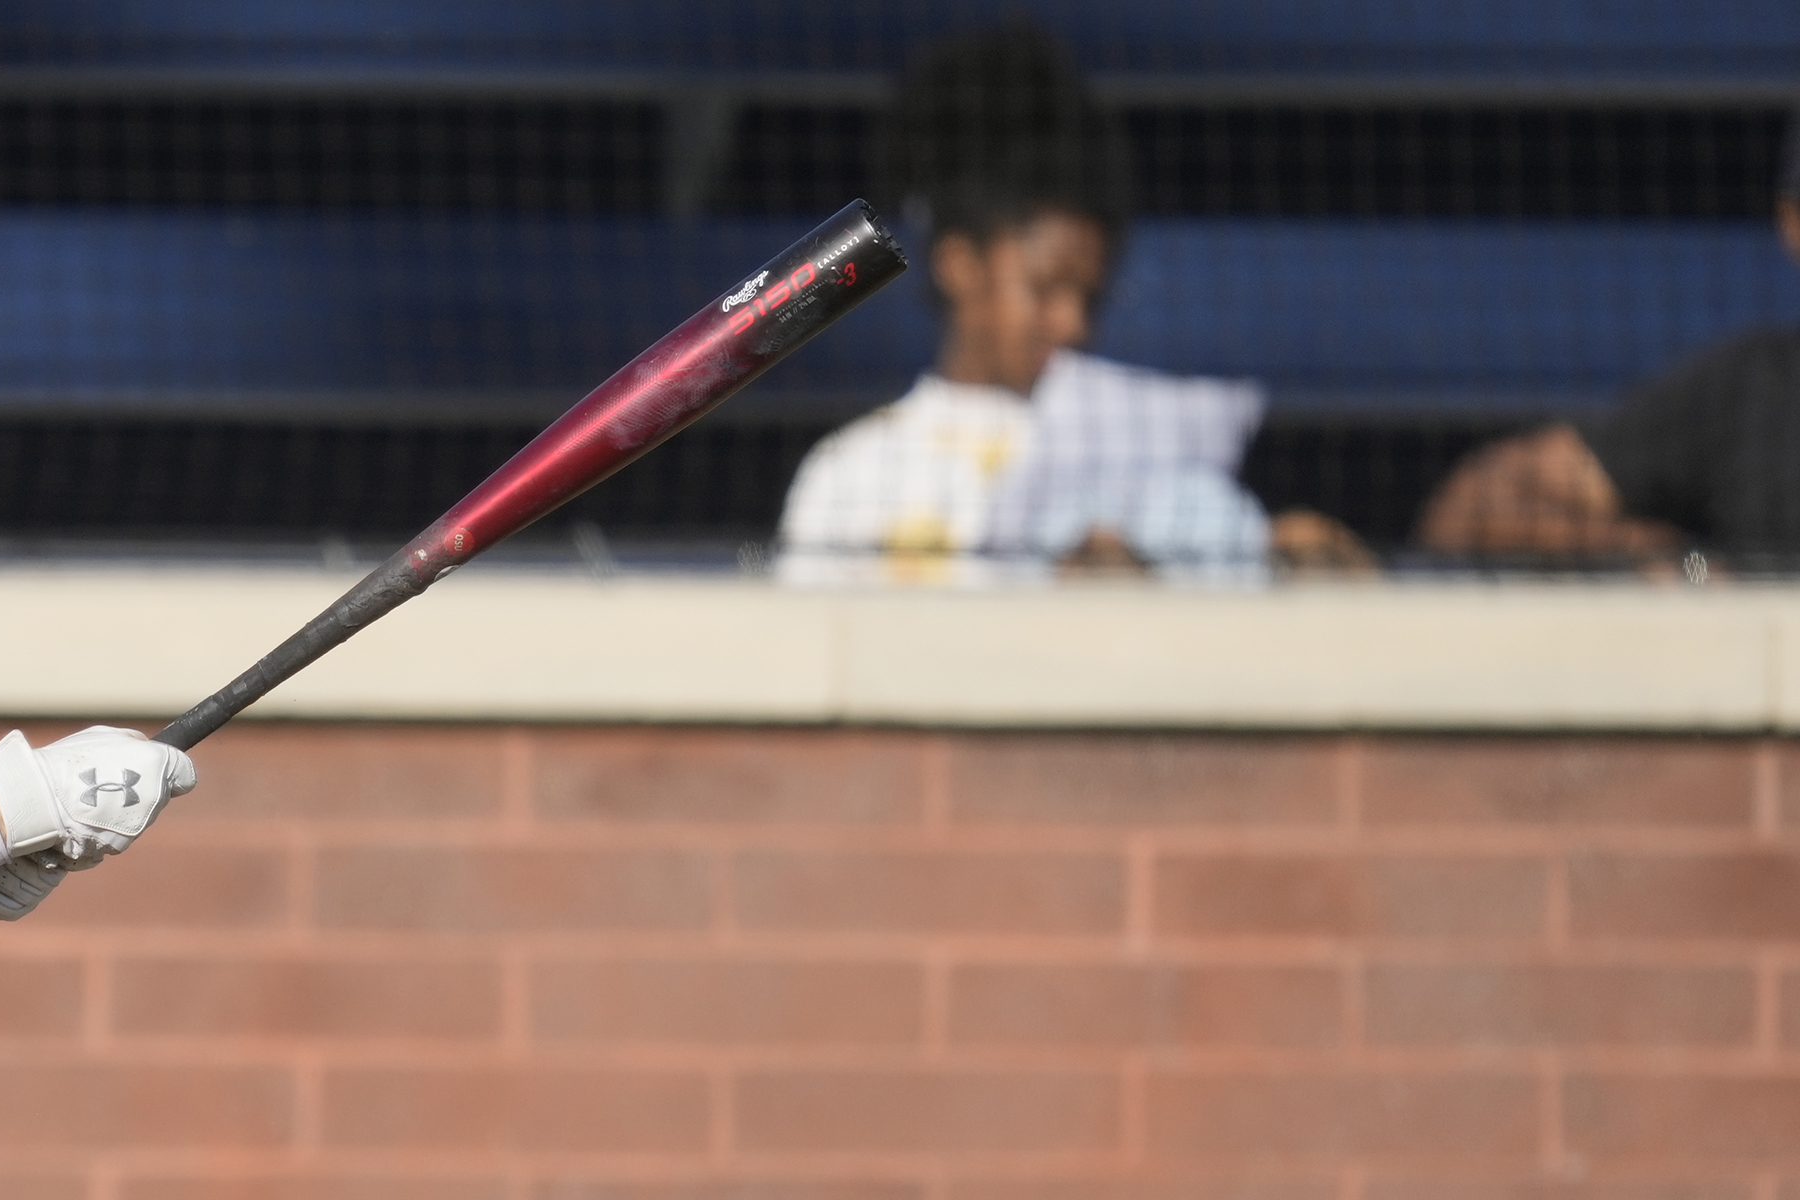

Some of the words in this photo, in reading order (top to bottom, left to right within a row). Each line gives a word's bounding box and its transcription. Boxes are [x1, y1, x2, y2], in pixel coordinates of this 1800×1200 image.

[837, 262, 857, 286] -3
[722, 270, 769, 312] Rawlings
[728, 262, 816, 336] 5150
[454, 534, 464, 551] OSU
